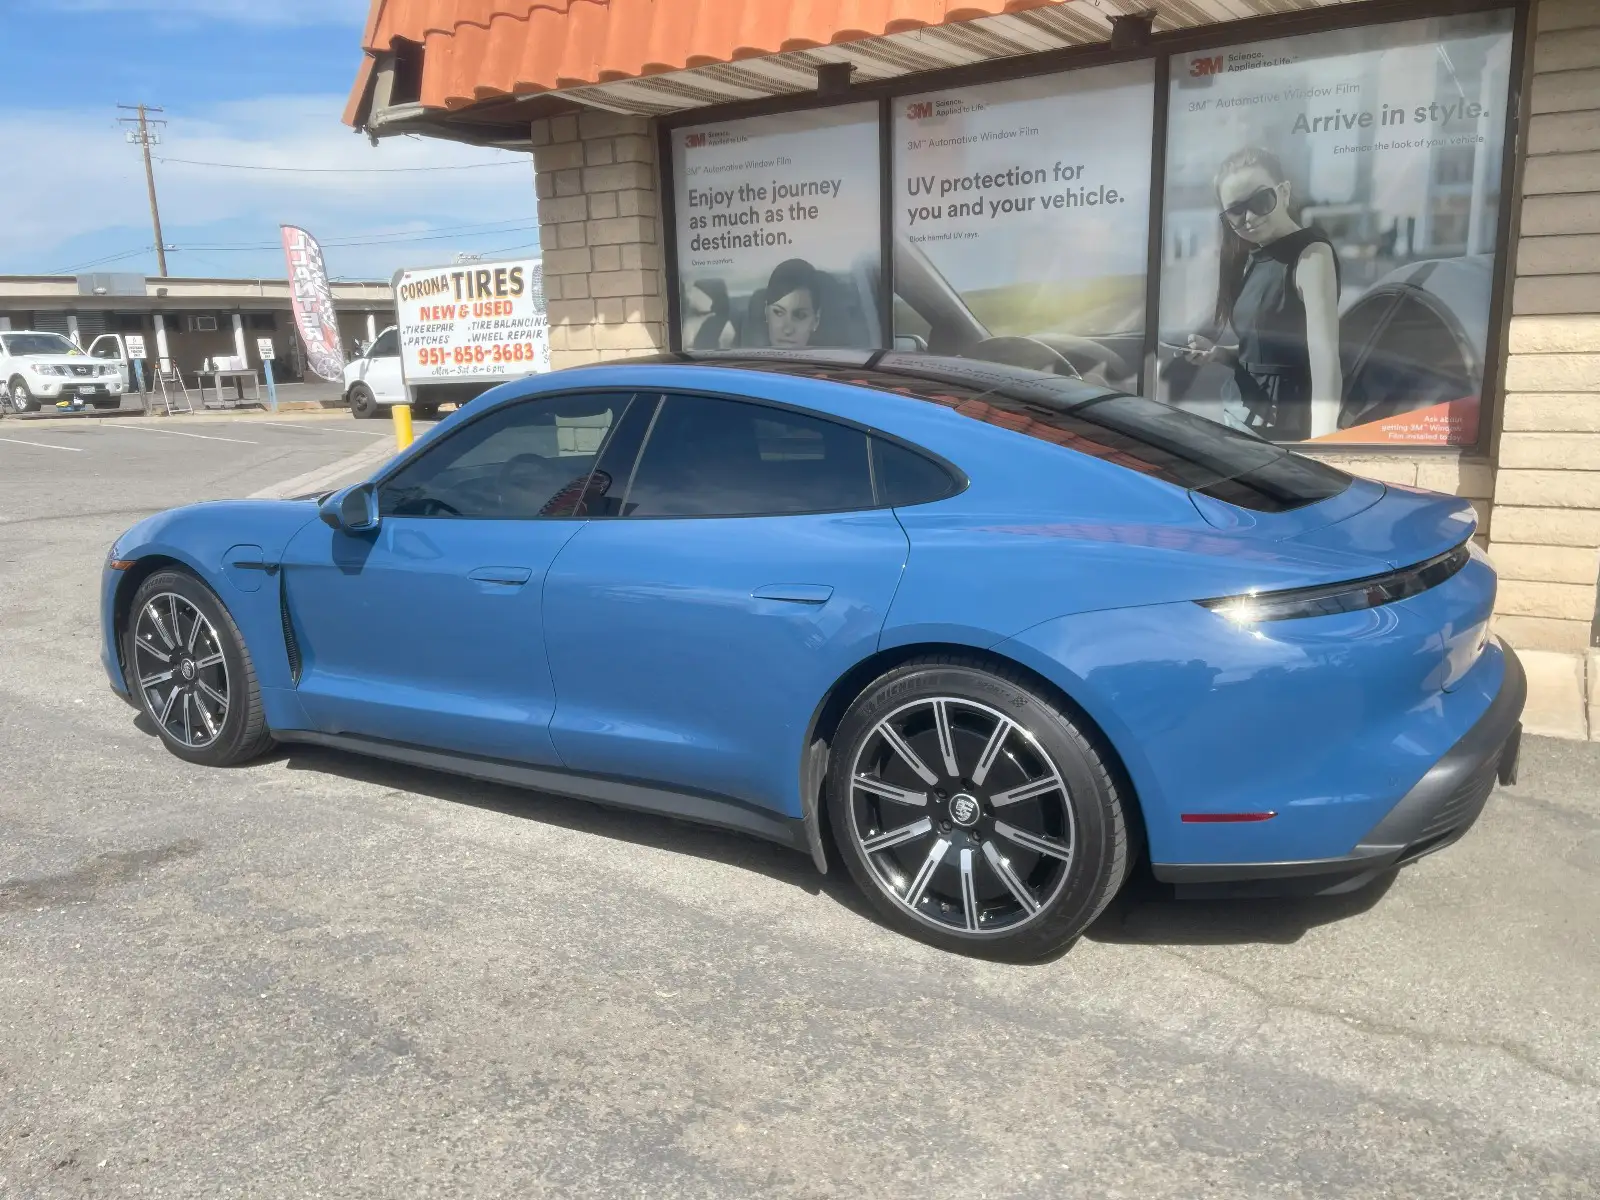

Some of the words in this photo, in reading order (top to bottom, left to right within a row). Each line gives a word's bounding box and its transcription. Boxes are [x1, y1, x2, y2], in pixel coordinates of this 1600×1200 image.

[1190, 55, 1223, 77] 3M
[1228, 61, 1263, 72] Applied
[1216, 93, 1280, 109] Automotive
[1283, 88, 1332, 100] Window
[1336, 83, 1360, 94] Film
[906, 101, 933, 120] 3M
[936, 106, 962, 117] Applied
[1291, 109, 1373, 135] Arrive
[1381, 103, 1405, 126] in
[1413, 96, 1490, 127] style.
[685, 132, 706, 148] 3M
[928, 134, 978, 148] Automotive
[980, 129, 1017, 142] Window
[1019, 126, 1039, 136] Film
[1333, 145, 1372, 155] Enhance
[1374, 142, 1389, 151] the
[1391, 140, 1411, 150] look
[1414, 138, 1424, 147] of
[1426, 138, 1446, 148] your
[703, 161, 743, 174] Automotive
[744, 159, 774, 169] Window
[776, 157, 792, 166] Film
[907, 175, 936, 197] UV
[940, 166, 1047, 198] protection
[1053, 161, 1085, 182] for
[688, 187, 734, 210] Enjoy
[737, 182, 767, 202] the
[771, 178, 842, 204] journey
[689, 215, 707, 230] as
[712, 206, 760, 228] much
[764, 208, 784, 223] as
[788, 201, 819, 221] the
[907, 205, 942, 226] you
[947, 196, 984, 218] and
[989, 196, 1036, 219] your
[1040, 185, 1125, 210] vehicle.
[690, 228, 793, 252] destination.
[401, 274, 450, 301] CORONA
[451, 266, 525, 302] TIRES
[420, 304, 456, 321] NEW
[458, 304, 470, 318] &
[472, 299, 514, 318] USED
[426, 322, 454, 332] REPAIR
[494, 316, 548, 329] BALANCING
[408, 335, 450, 346] PATCHES
[472, 332, 504, 343] WHEEL
[507, 330, 543, 340] REPAIR
[418, 343, 534, 366] 951-858-3683
[1381, 424, 1407, 432] getting
